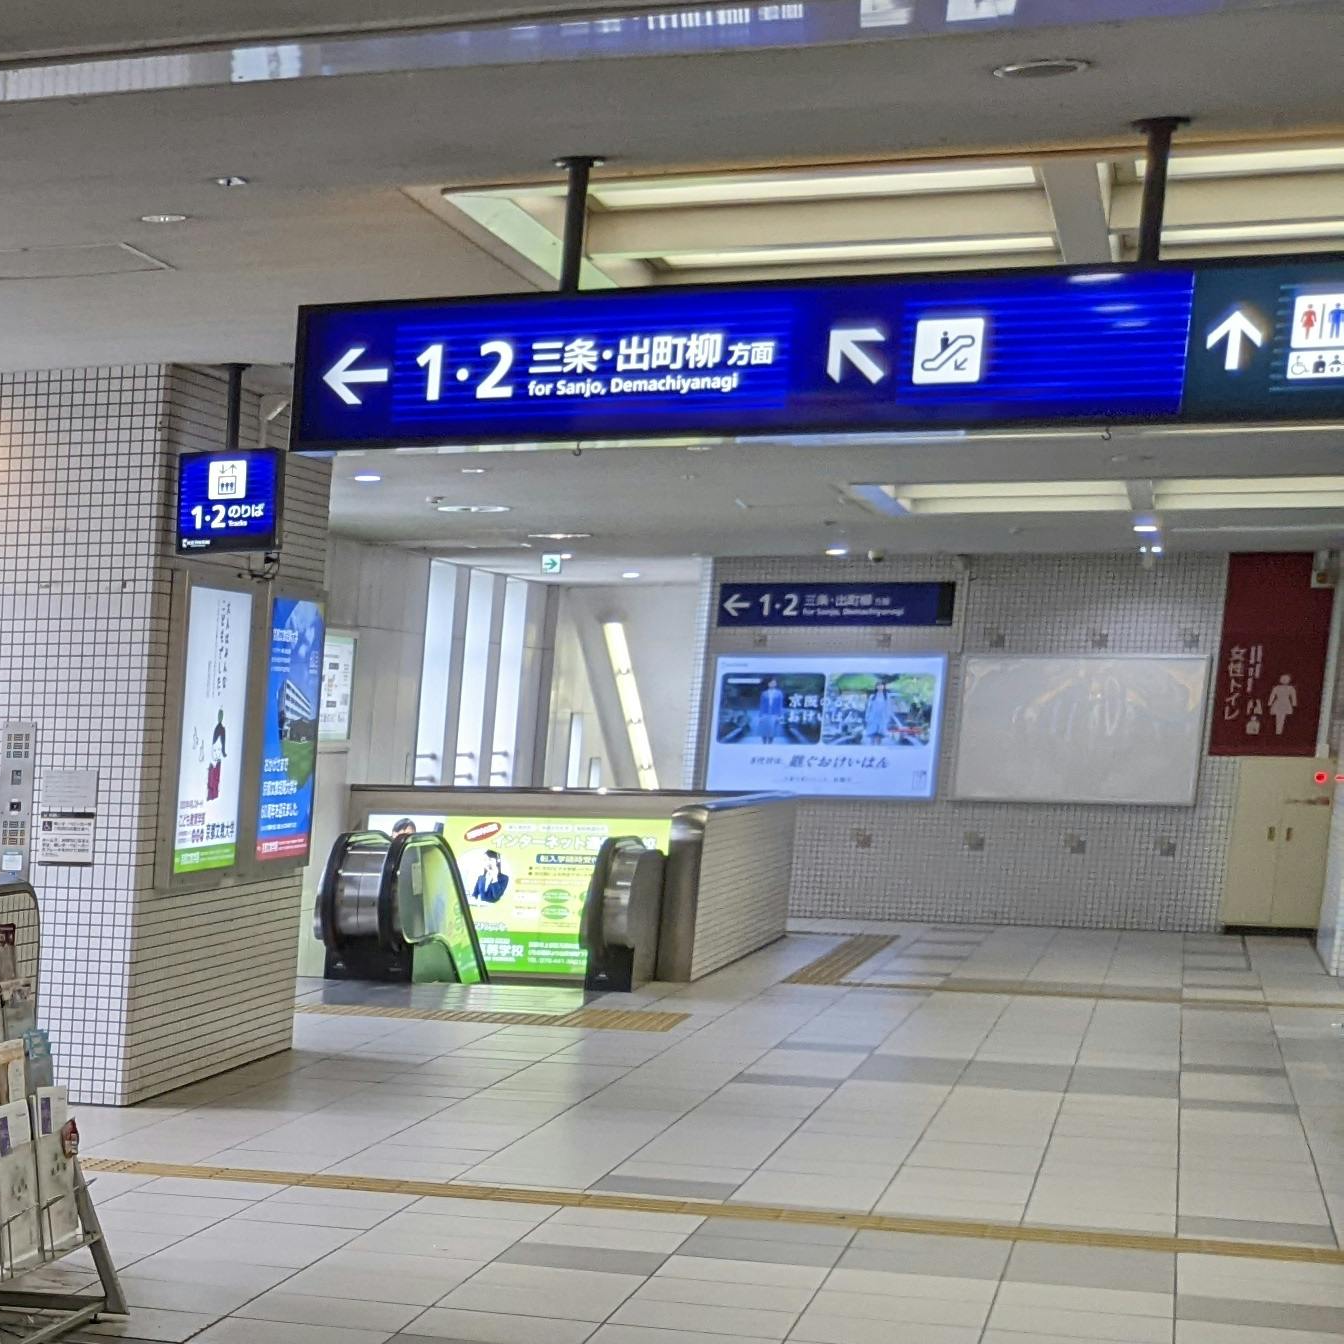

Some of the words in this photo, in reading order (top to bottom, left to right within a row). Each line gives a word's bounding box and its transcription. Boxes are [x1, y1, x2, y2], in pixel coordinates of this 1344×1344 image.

[528, 333, 723, 373] 三条・出町柳
[727, 341, 775, 366] 方面
[528, 379, 551, 396] for
[556, 379, 607, 398] Sanjo,
[610, 372, 739, 395] Demachiyanagi
[228, 503, 265, 518] のりば
[1224, 645, 1248, 720] 女性トイレ
